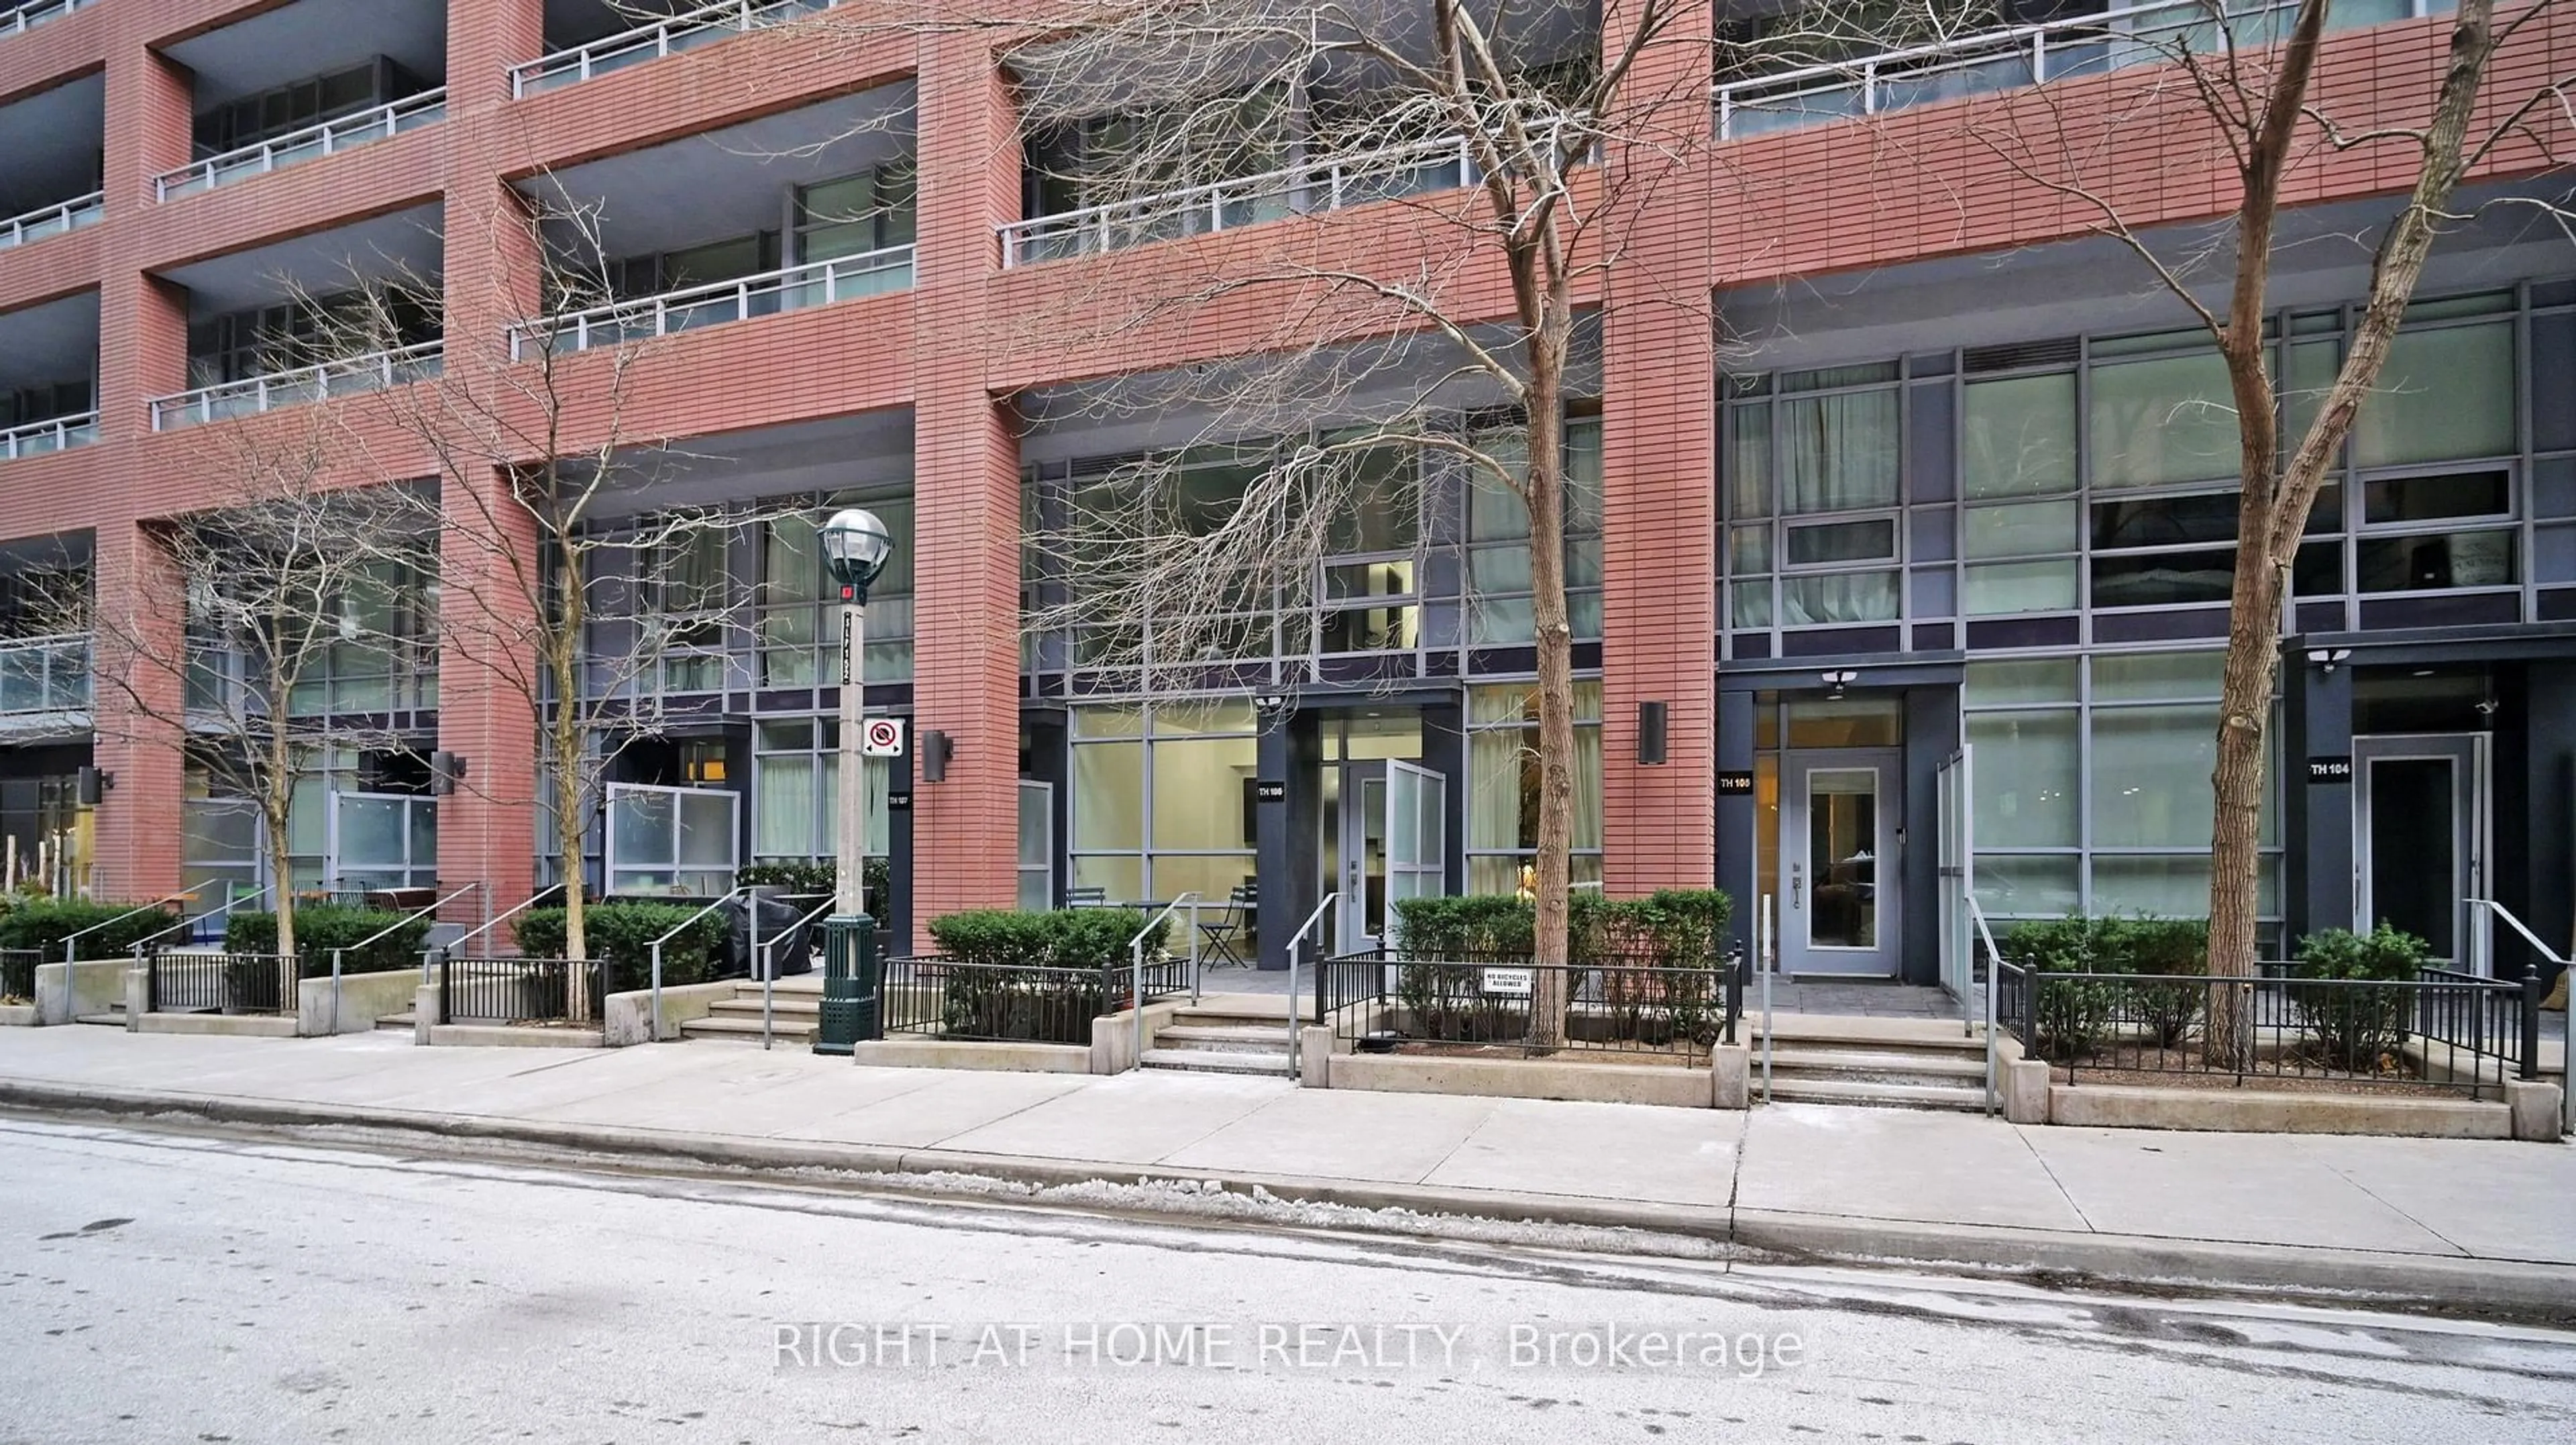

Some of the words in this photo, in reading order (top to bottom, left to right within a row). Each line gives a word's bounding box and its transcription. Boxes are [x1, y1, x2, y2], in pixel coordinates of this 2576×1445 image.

[2310, 763, 2327, 775] TH
[2329, 763, 2349, 774] 104
[1721, 778, 1733, 788] TH
[1258, 787, 1269, 796] TH
